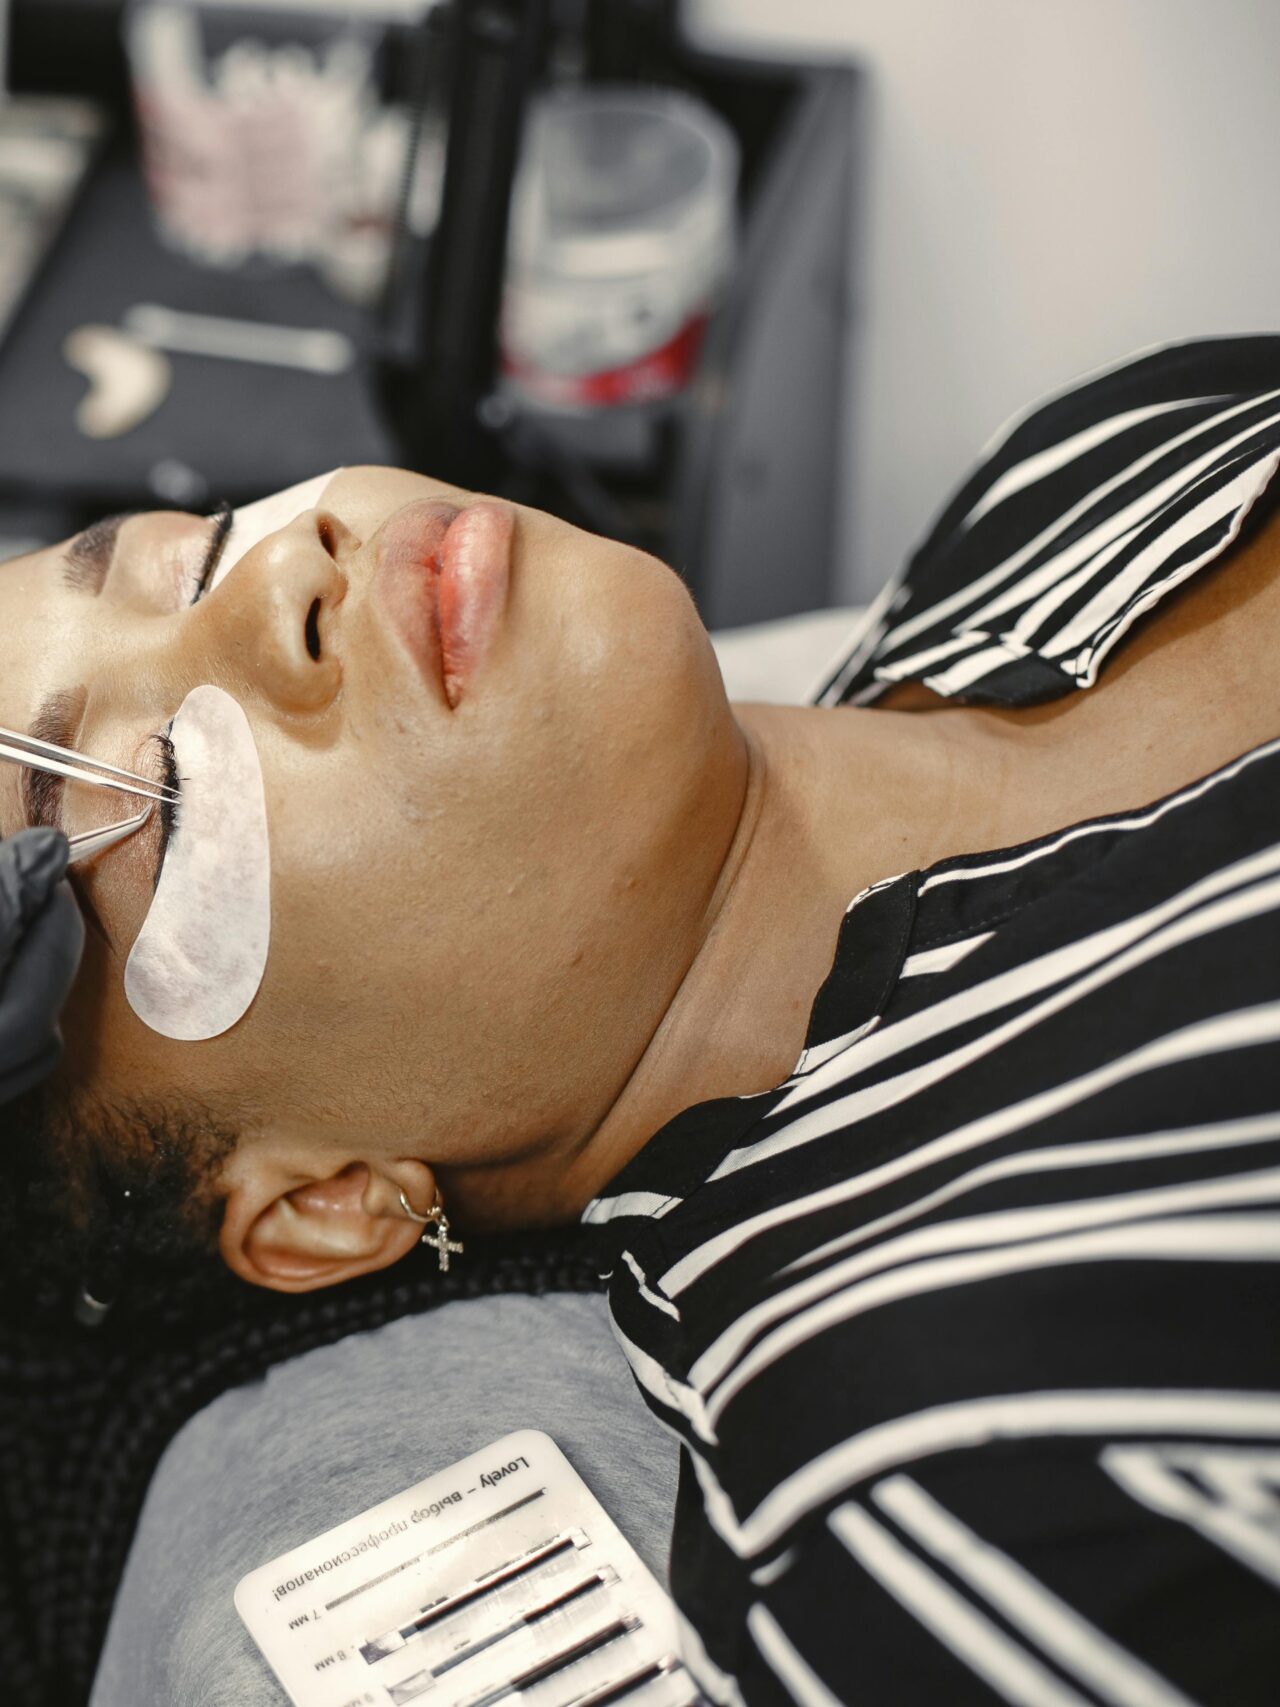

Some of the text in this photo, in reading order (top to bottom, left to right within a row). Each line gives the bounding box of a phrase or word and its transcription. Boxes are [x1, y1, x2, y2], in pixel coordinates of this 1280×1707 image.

[480, 1456, 530, 1488] Lovely
[411, 1491, 462, 1524] выбор
[273, 1521, 408, 1601] профессионалов!
[288, 1609, 322, 1630] 7 мм
[314, 1649, 347, 1671] 8 мм
